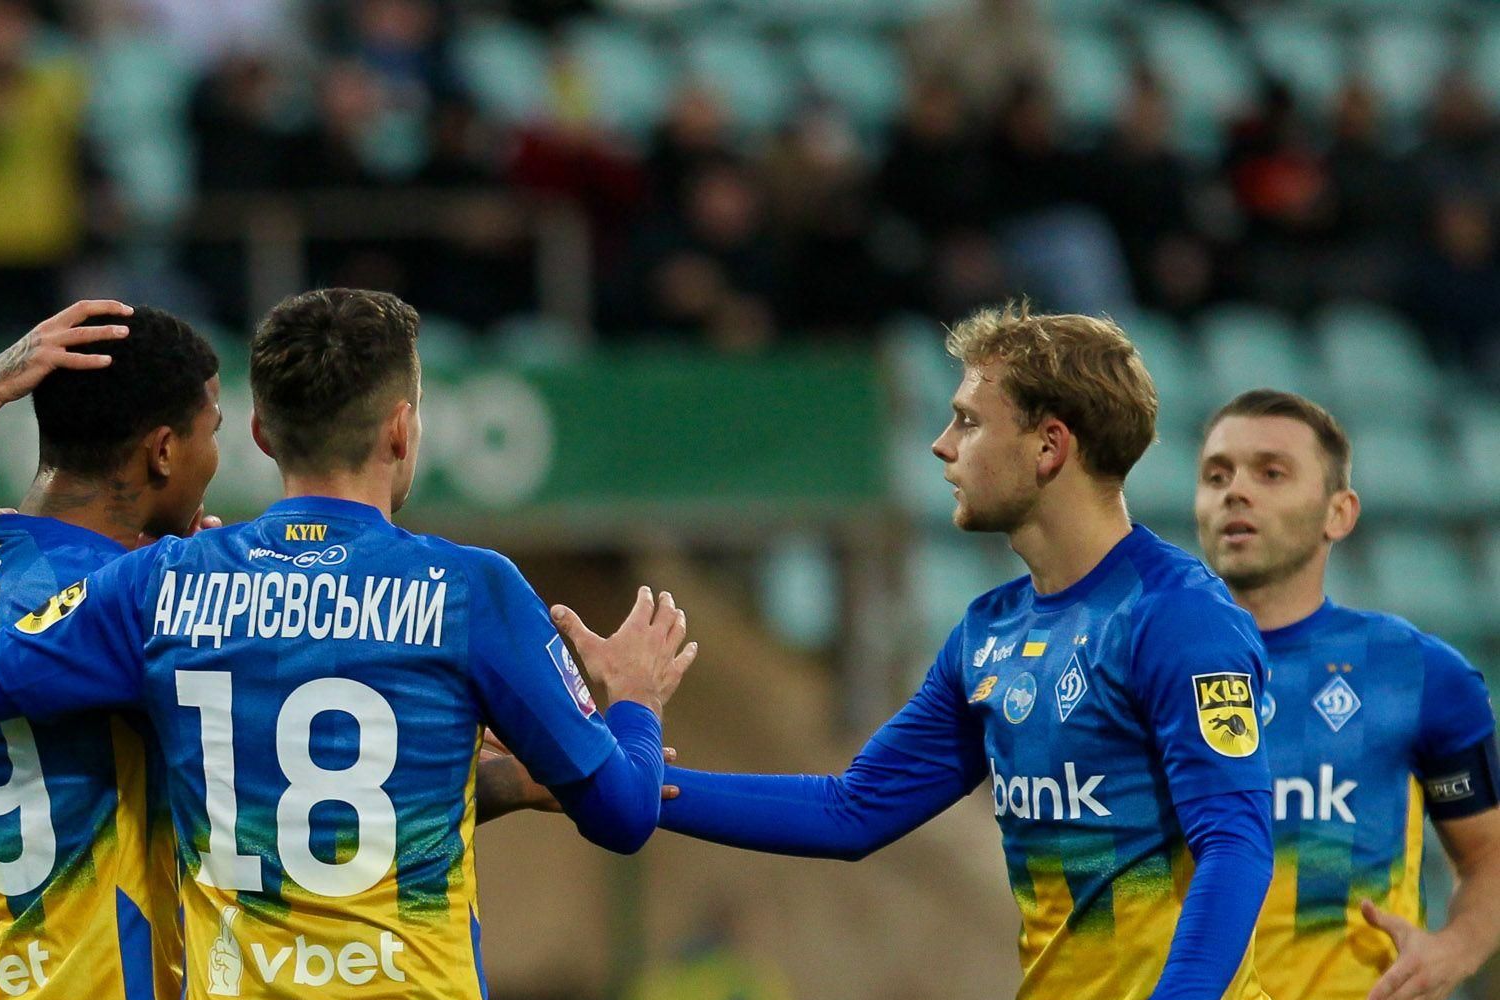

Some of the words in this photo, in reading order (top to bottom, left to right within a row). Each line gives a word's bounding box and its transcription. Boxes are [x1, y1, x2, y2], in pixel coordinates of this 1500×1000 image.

[248, 547, 294, 561] Money
[285, 524, 328, 541] KYIV
[153, 566, 448, 649] АНДРІЄВСЬКИЙ
[175, 669, 399, 898] 18
[990, 757, 1113, 820] bank
[250, 930, 406, 987] vbet
